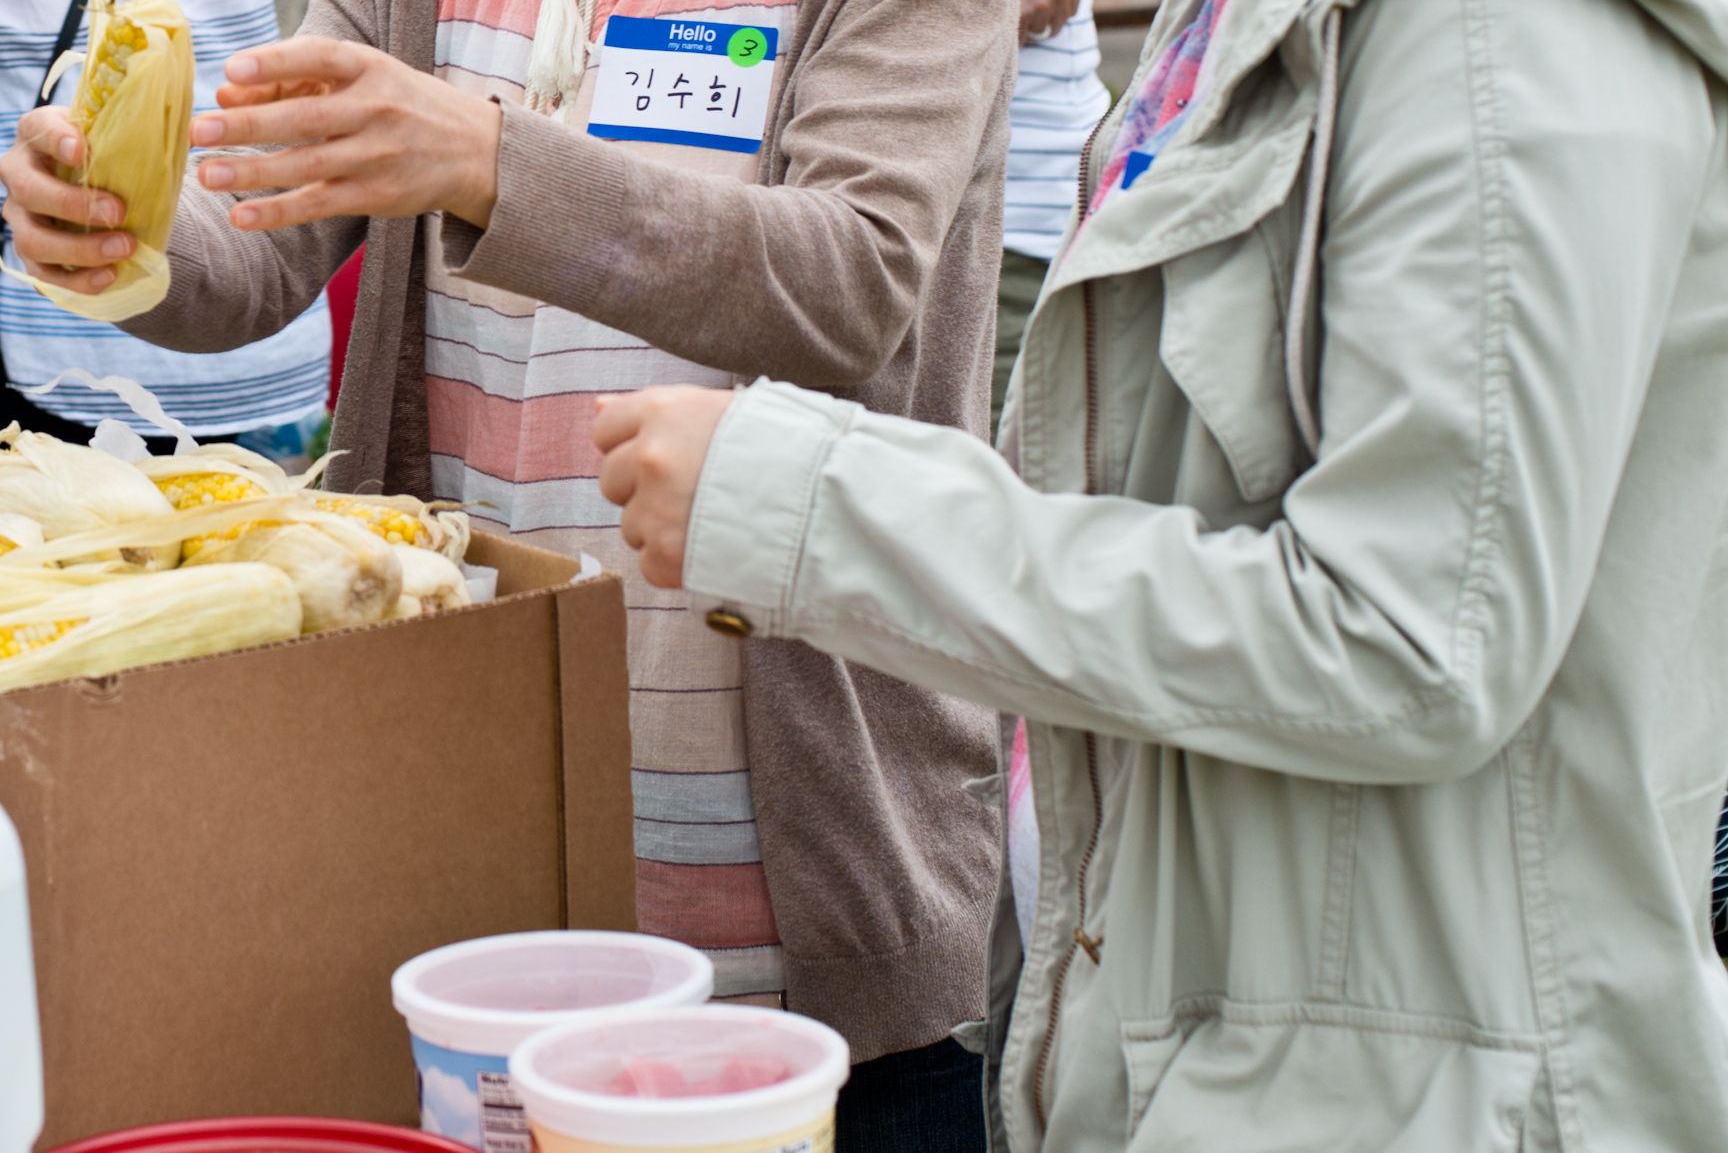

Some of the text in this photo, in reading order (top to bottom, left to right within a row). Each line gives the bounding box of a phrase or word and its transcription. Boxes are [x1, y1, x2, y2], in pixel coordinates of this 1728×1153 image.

[669, 23, 717, 42] Hello
[668, 42, 713, 51] my name is
[739, 39, 758, 56] 3
[625, 68, 741, 118] 김수희
